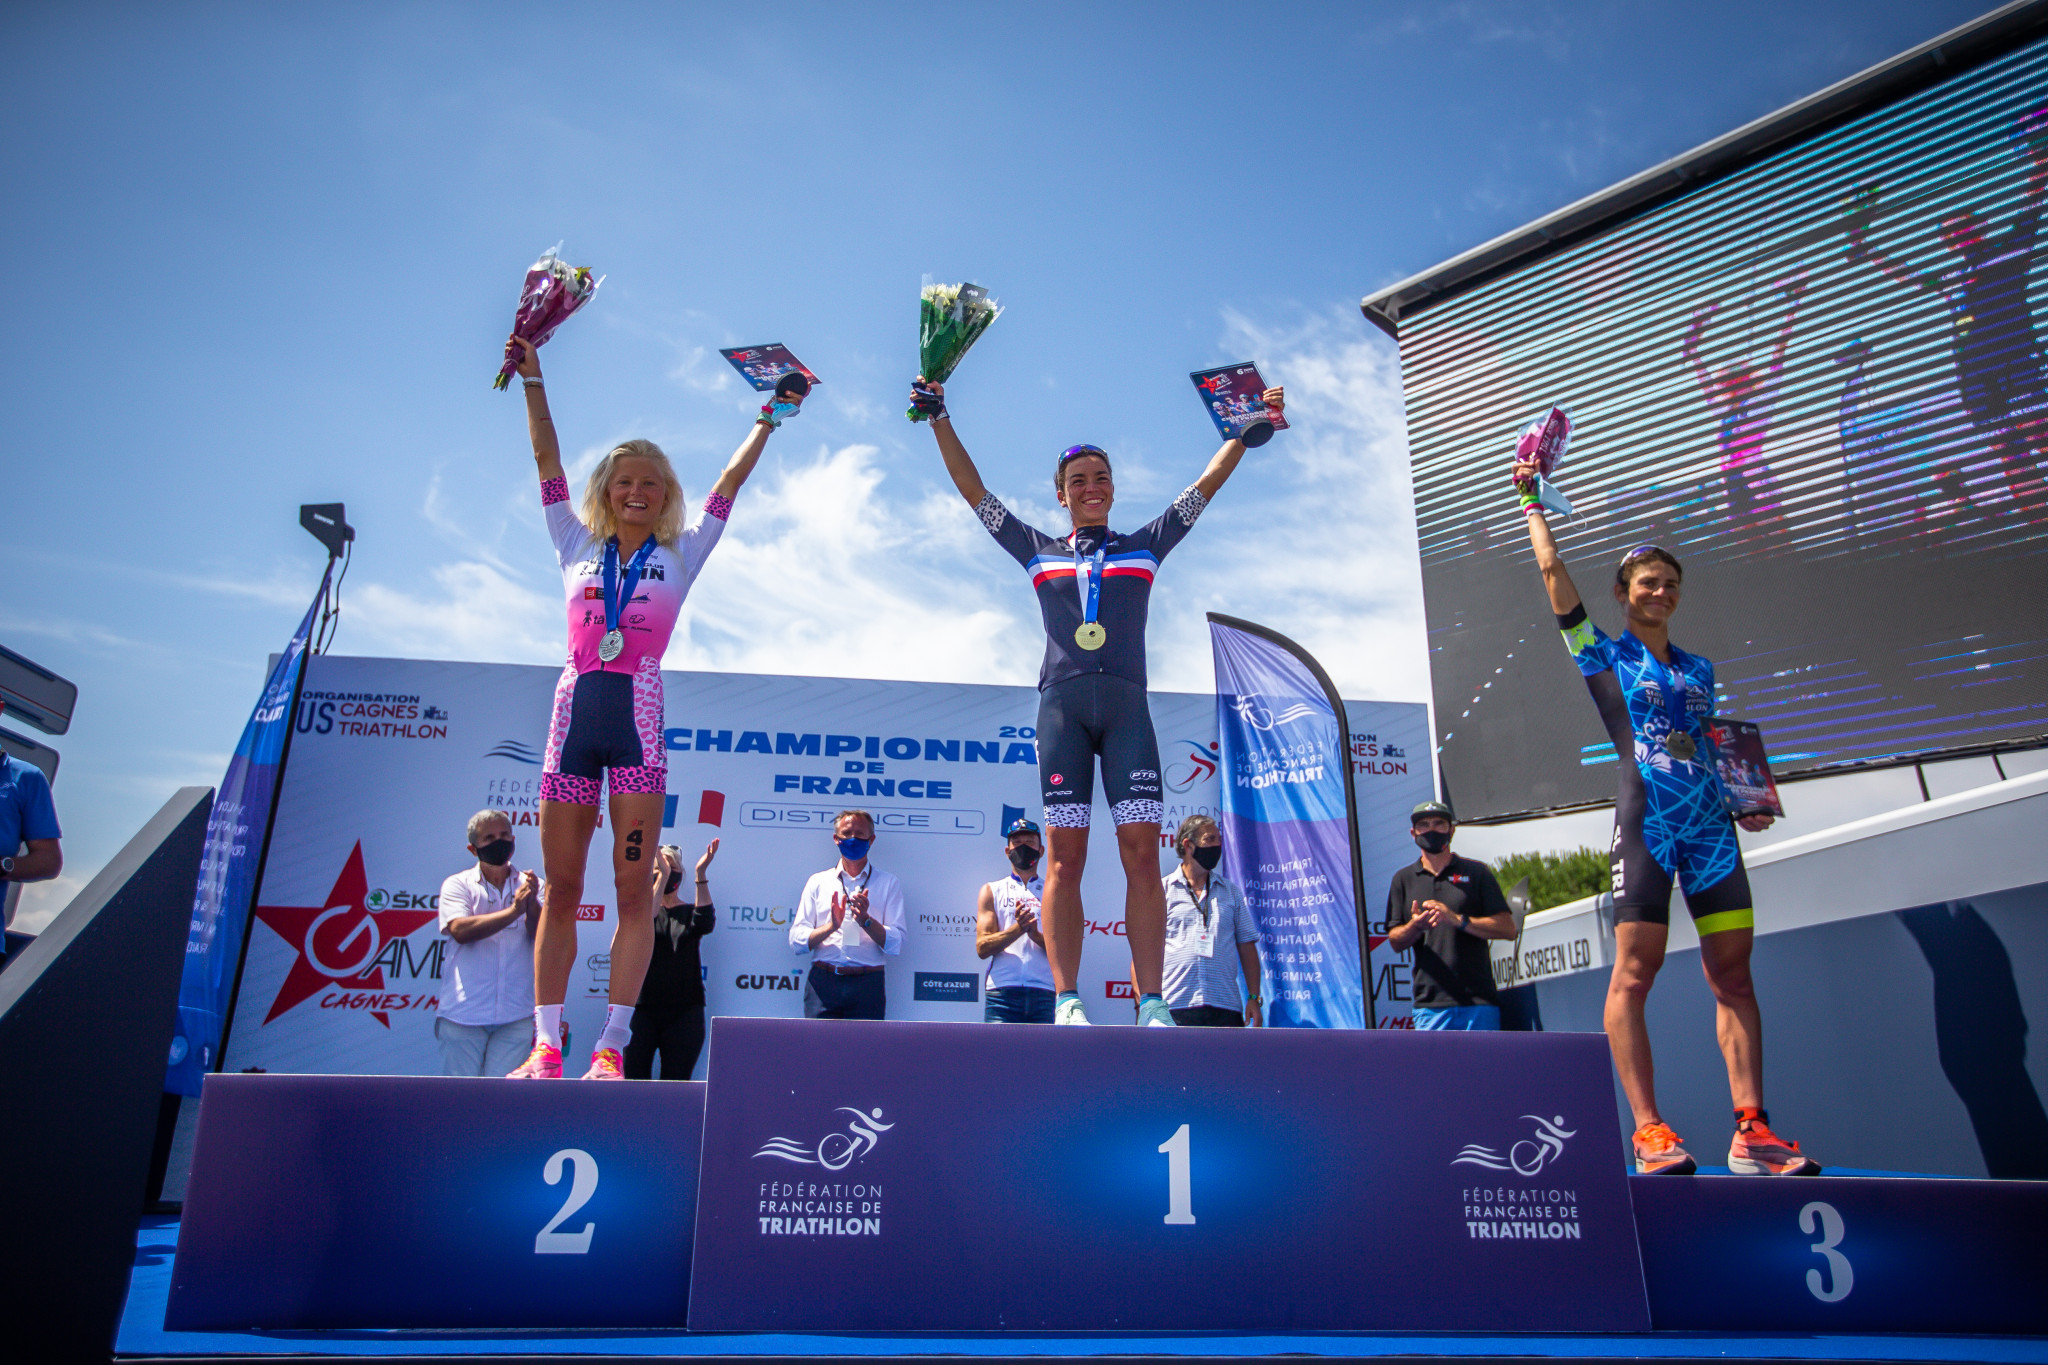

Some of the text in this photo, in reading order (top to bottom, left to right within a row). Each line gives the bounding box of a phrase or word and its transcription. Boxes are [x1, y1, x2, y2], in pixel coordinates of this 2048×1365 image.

[302, 690, 420, 704] ORGANISATION
[297, 702, 419, 735] US CAGNES
[338, 721, 448, 740] TRIATHLON
[844, 760, 885, 775] DE
[774, 774, 952, 799] FRANCE
[955, 816, 975, 829] L
[1611, 858, 1626, 899] TRI
[1524, 944, 1566, 978] SCREEN
[1568, 938, 1591, 969] LED
[1158, 1123, 1197, 1225] 1
[760, 1181, 882, 1198] FÉDÉRATION
[1462, 1186, 1577, 1203] FÉDÉRATION
[534, 1148, 599, 1254] 2
[759, 1200, 881, 1216] FRANÇAISE DE
[1464, 1205, 1580, 1220] FRANÇAISE DE
[759, 1217, 881, 1236] TRIATHLON
[1465, 1221, 1581, 1239] TRIATHLON
[1799, 1200, 1855, 1302] 3
